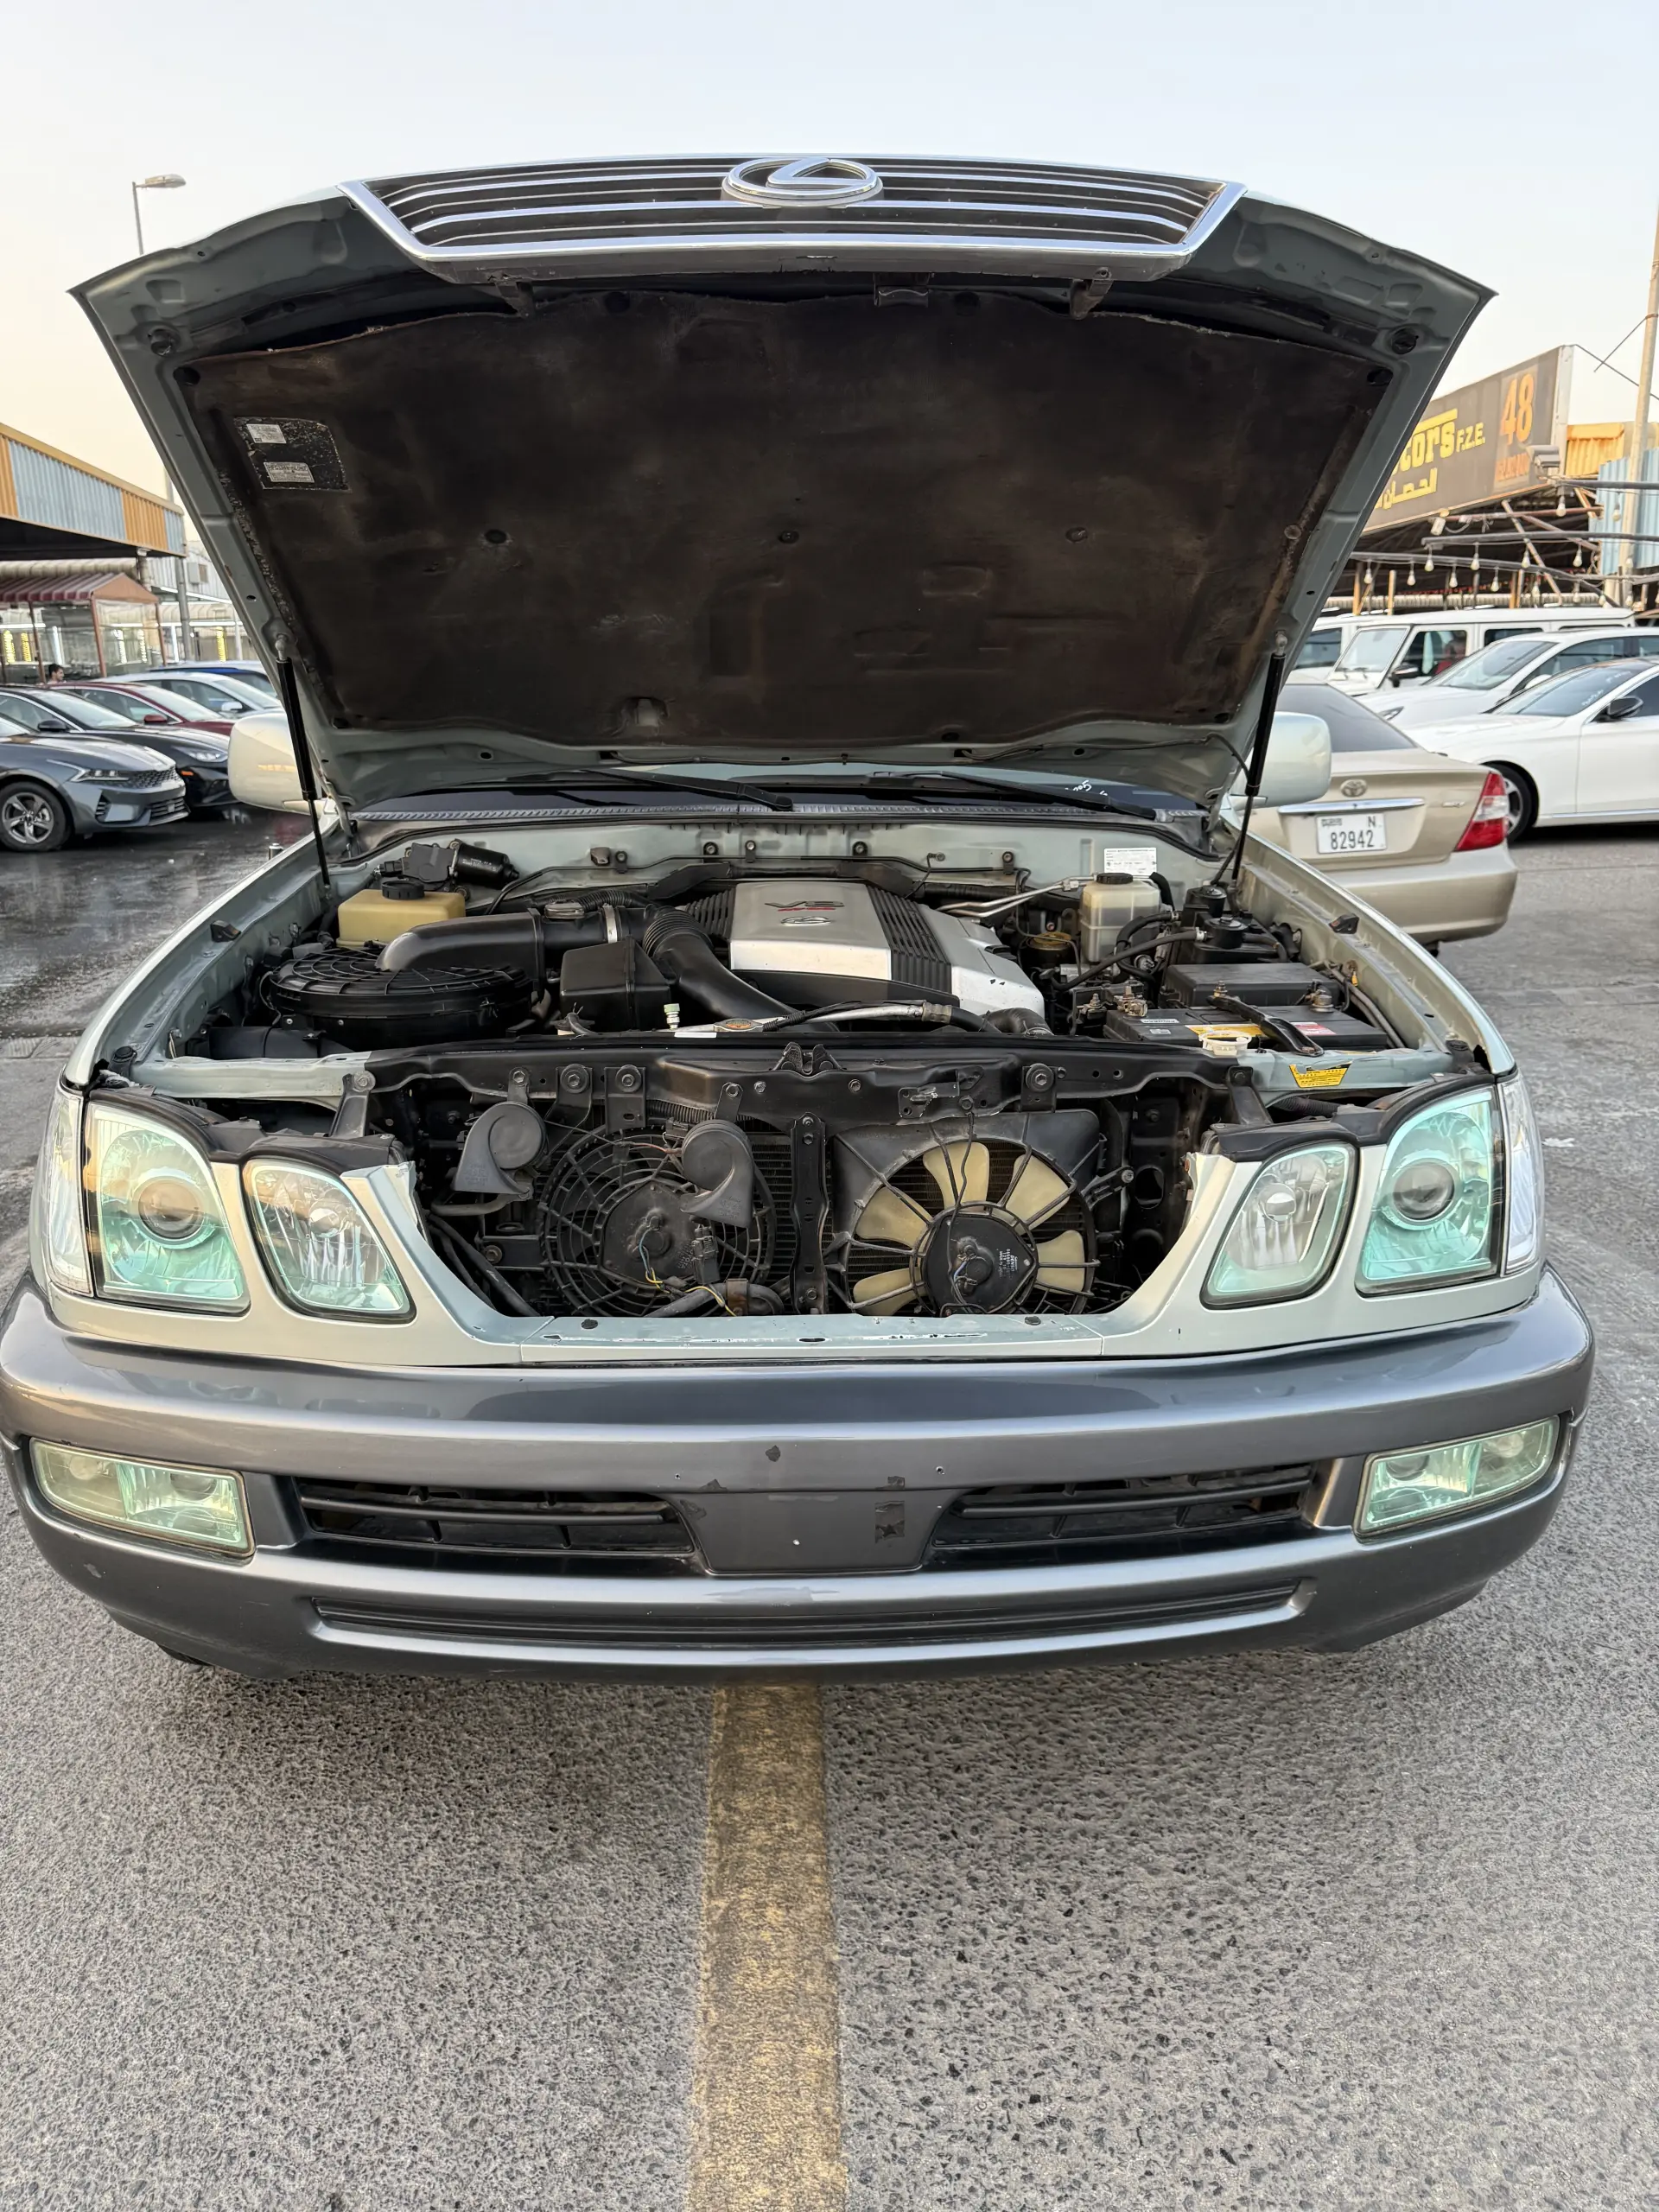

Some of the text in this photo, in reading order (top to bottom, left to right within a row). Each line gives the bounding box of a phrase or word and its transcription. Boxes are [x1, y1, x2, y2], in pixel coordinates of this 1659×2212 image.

[1500, 374, 1535, 445] 48
[1368, 816, 1376, 828] N
[1331, 830, 1375, 850] 82942
